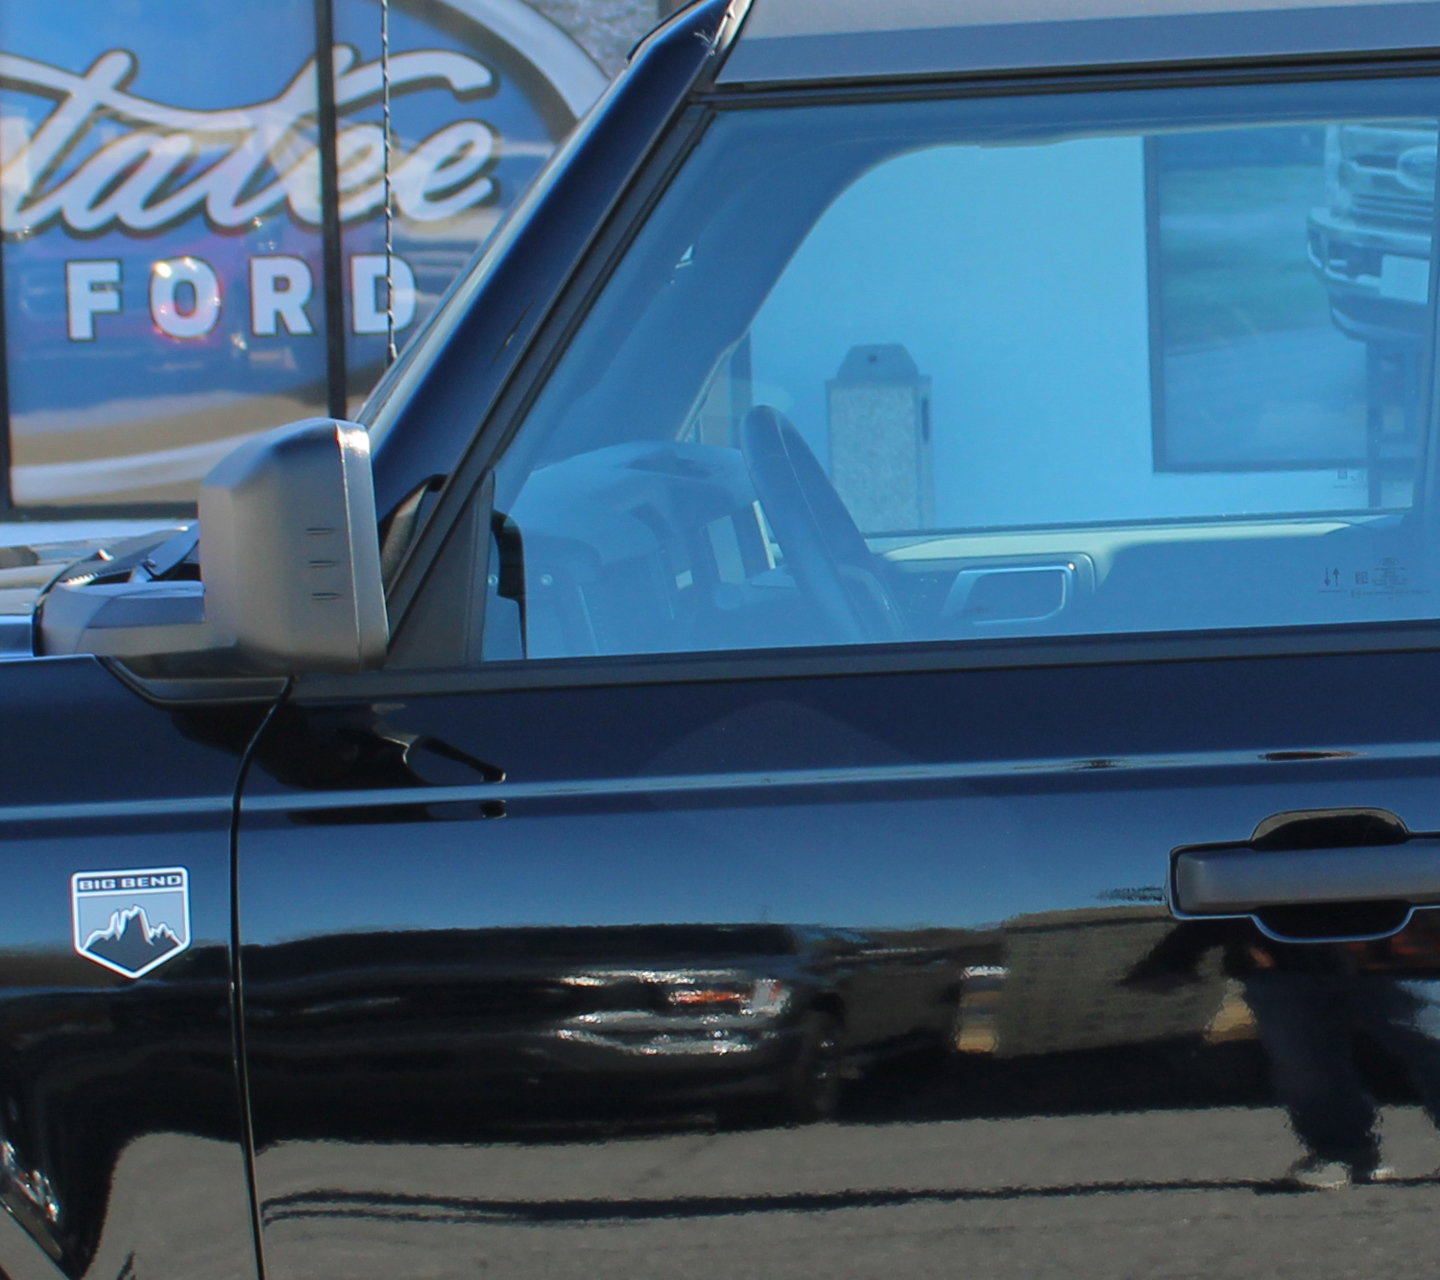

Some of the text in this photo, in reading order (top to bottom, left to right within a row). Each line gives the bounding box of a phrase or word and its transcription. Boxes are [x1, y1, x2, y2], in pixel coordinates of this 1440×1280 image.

[64, 254, 418, 342] FORD
[79, 875, 182, 890] BIG BEND
